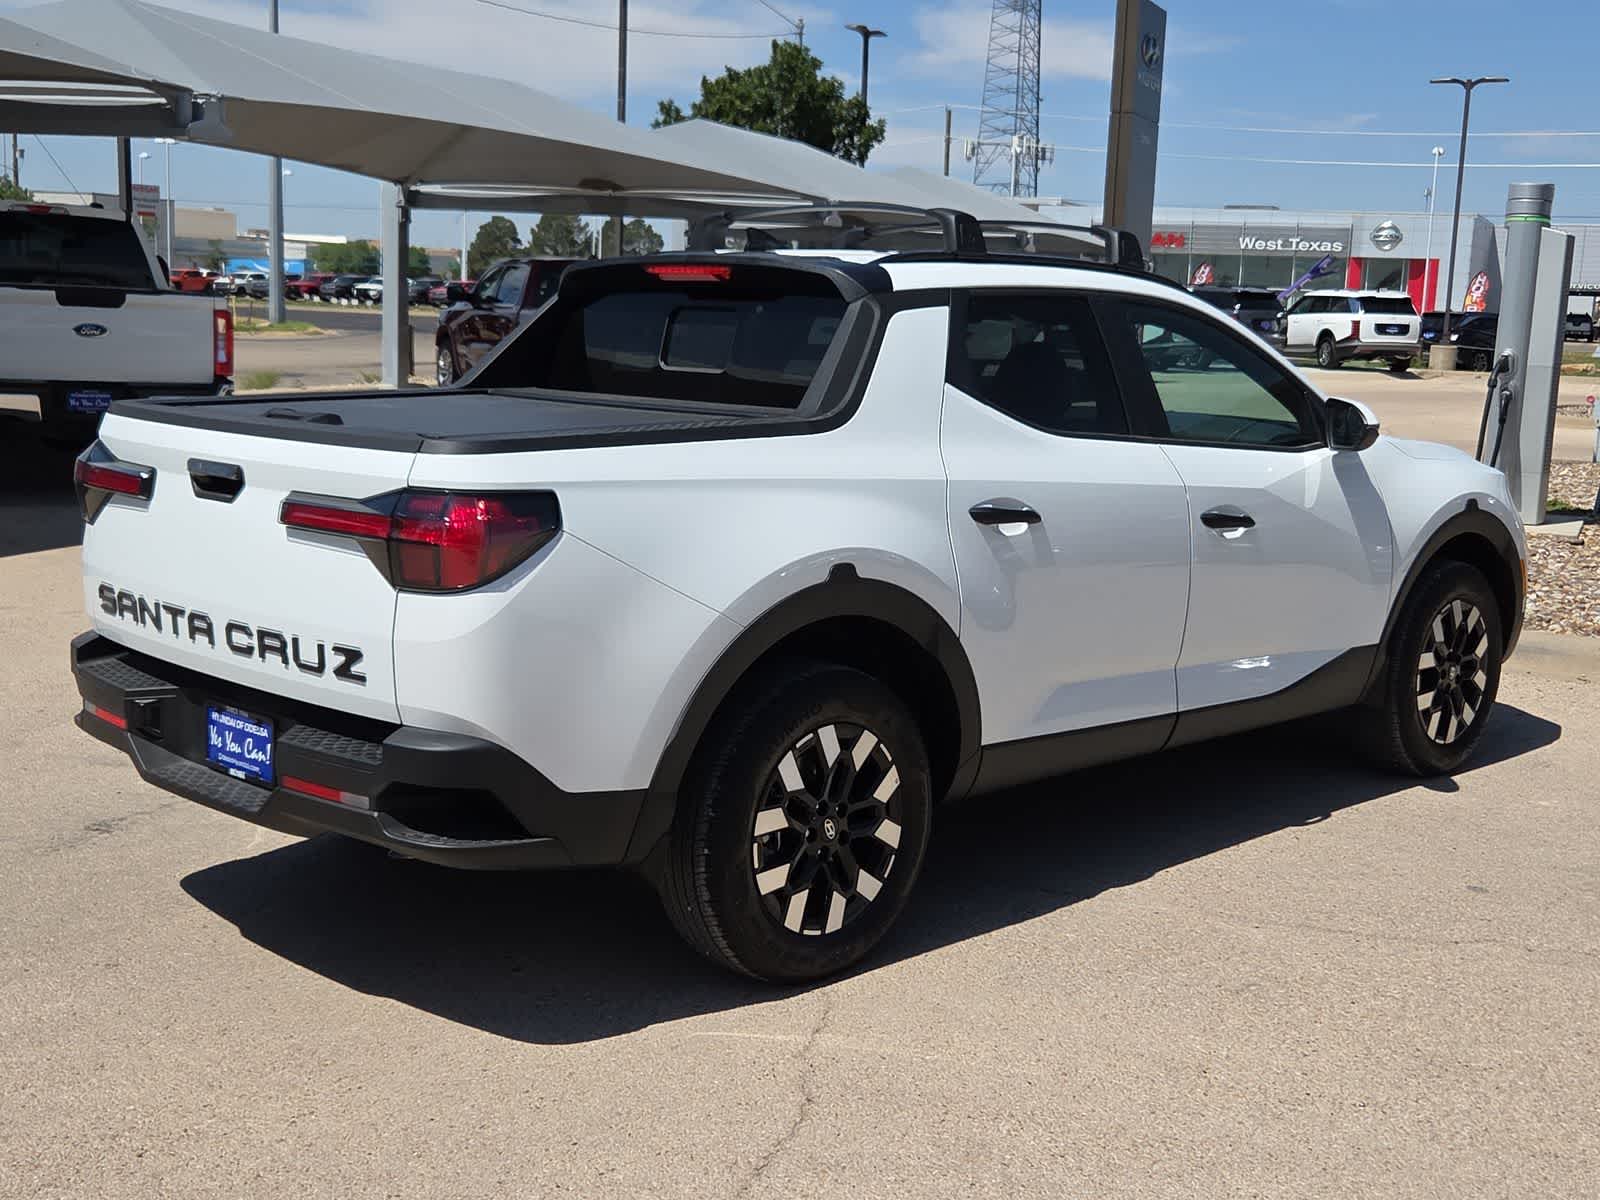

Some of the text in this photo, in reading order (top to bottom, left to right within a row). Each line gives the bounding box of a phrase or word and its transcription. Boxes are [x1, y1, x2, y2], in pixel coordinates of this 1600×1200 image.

[1239, 236, 1344, 252] West Texas
[98, 581, 367, 686] SANTA CRUZ
[209, 725, 223, 748] Yes
[225, 731, 242, 753] You
[244, 738, 271, 765] Can!
